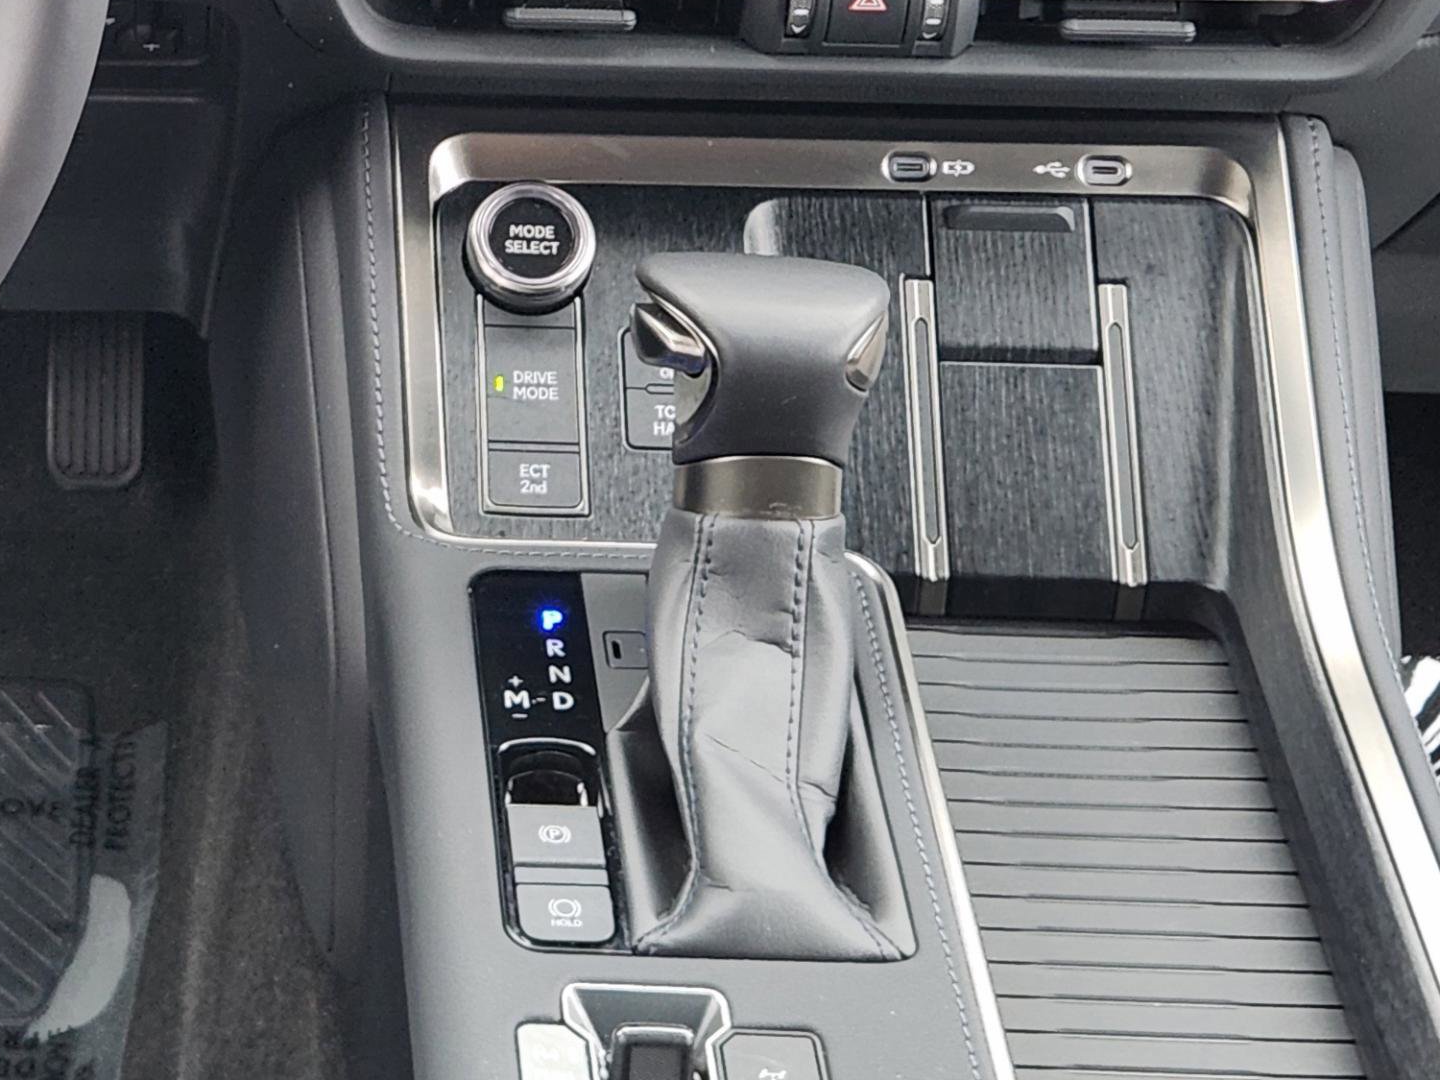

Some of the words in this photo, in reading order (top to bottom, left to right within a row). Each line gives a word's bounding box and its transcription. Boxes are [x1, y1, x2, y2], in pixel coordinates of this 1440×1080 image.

[509, 224, 555, 240] MODE
[505, 240, 559, 256] SELECT
[513, 371, 558, 385] DRIVE
[513, 386, 559, 401] MODE
[519, 464, 550, 478] ECT
[520, 479, 547, 494] 2nd
[542, 610, 563, 630] P
[545, 638, 566, 657] R
[547, 665, 571, 684] N
[503, 690, 531, 710] M
[552, 691, 574, 710] D
[550, 918, 582, 927] HOLD
